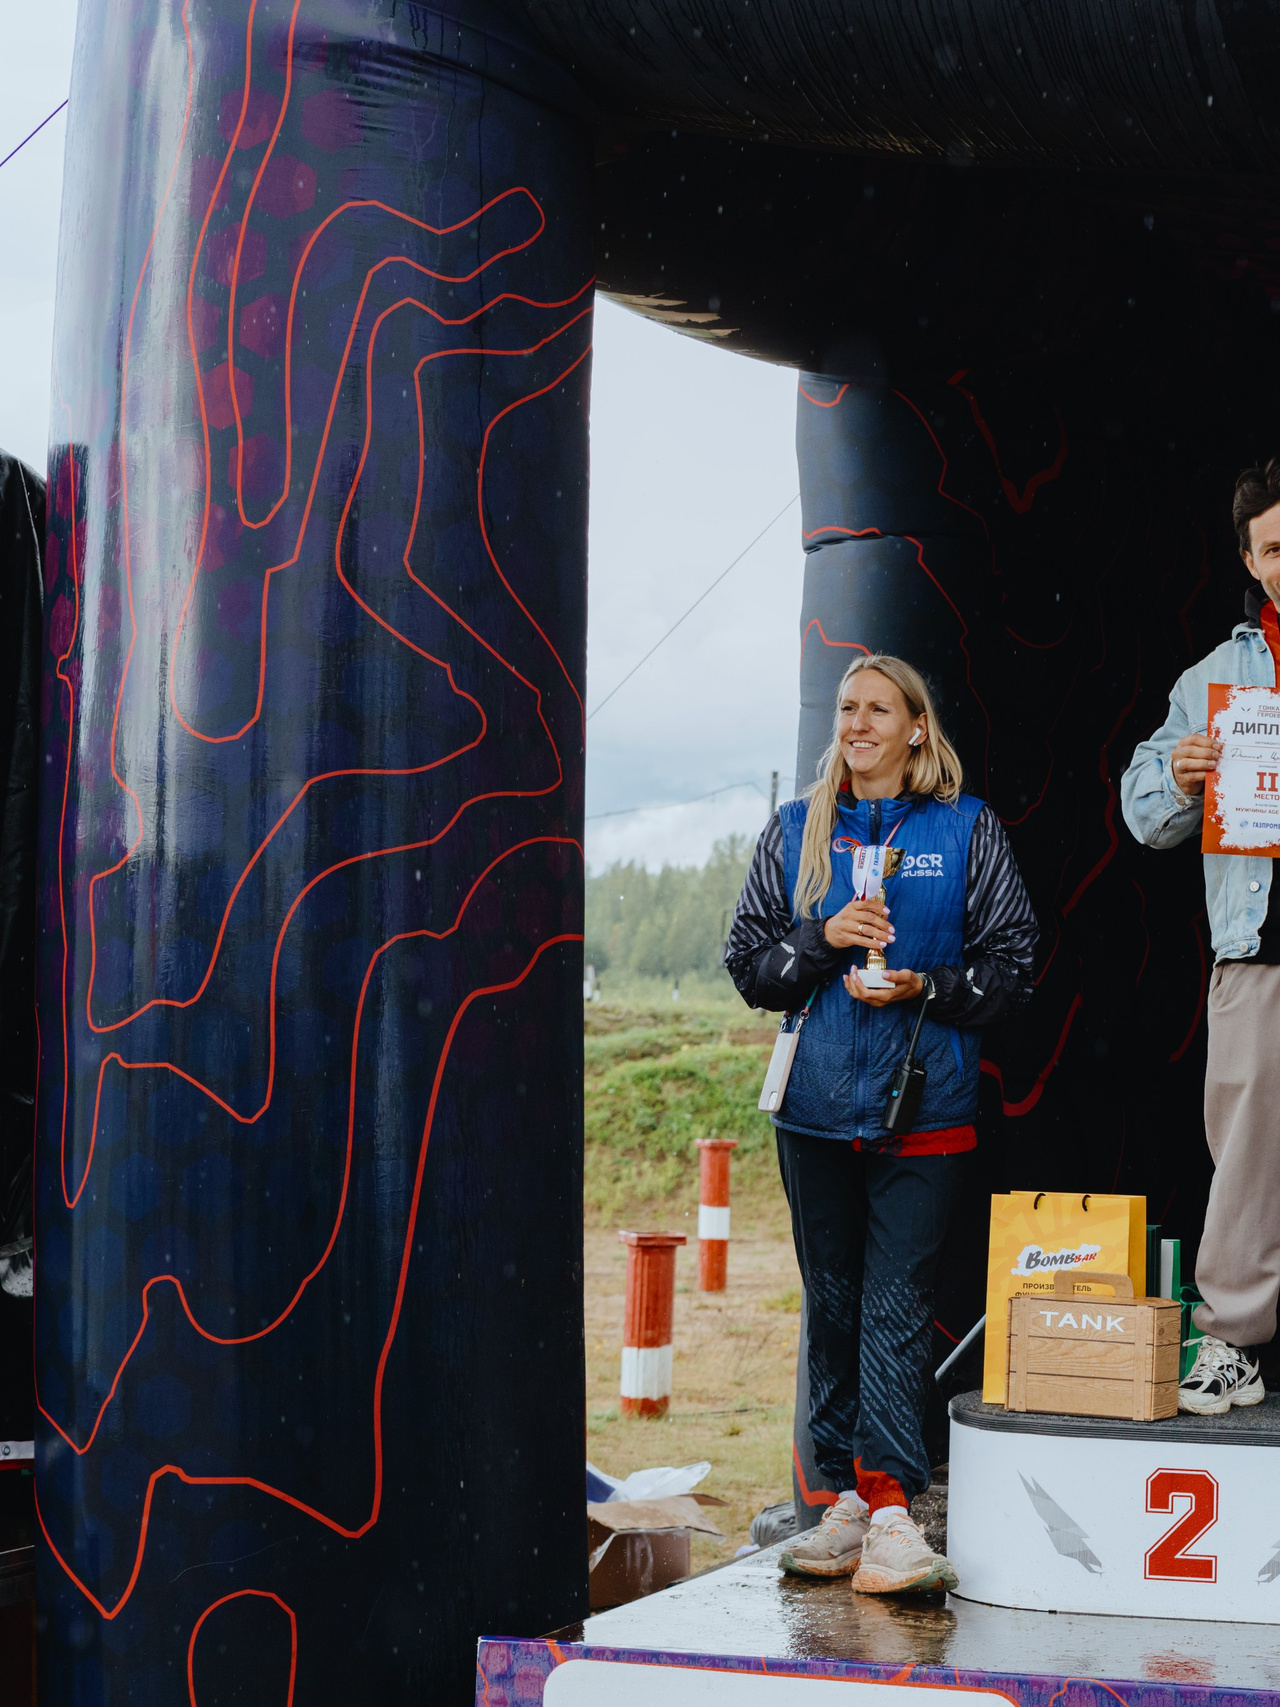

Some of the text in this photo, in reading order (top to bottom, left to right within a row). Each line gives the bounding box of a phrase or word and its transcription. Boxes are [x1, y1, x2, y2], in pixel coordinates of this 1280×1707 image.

[901, 869, 944, 879] RUSSIA
[1039, 1310, 1125, 1333] TANK
[1144, 1468, 1218, 1583] 2
